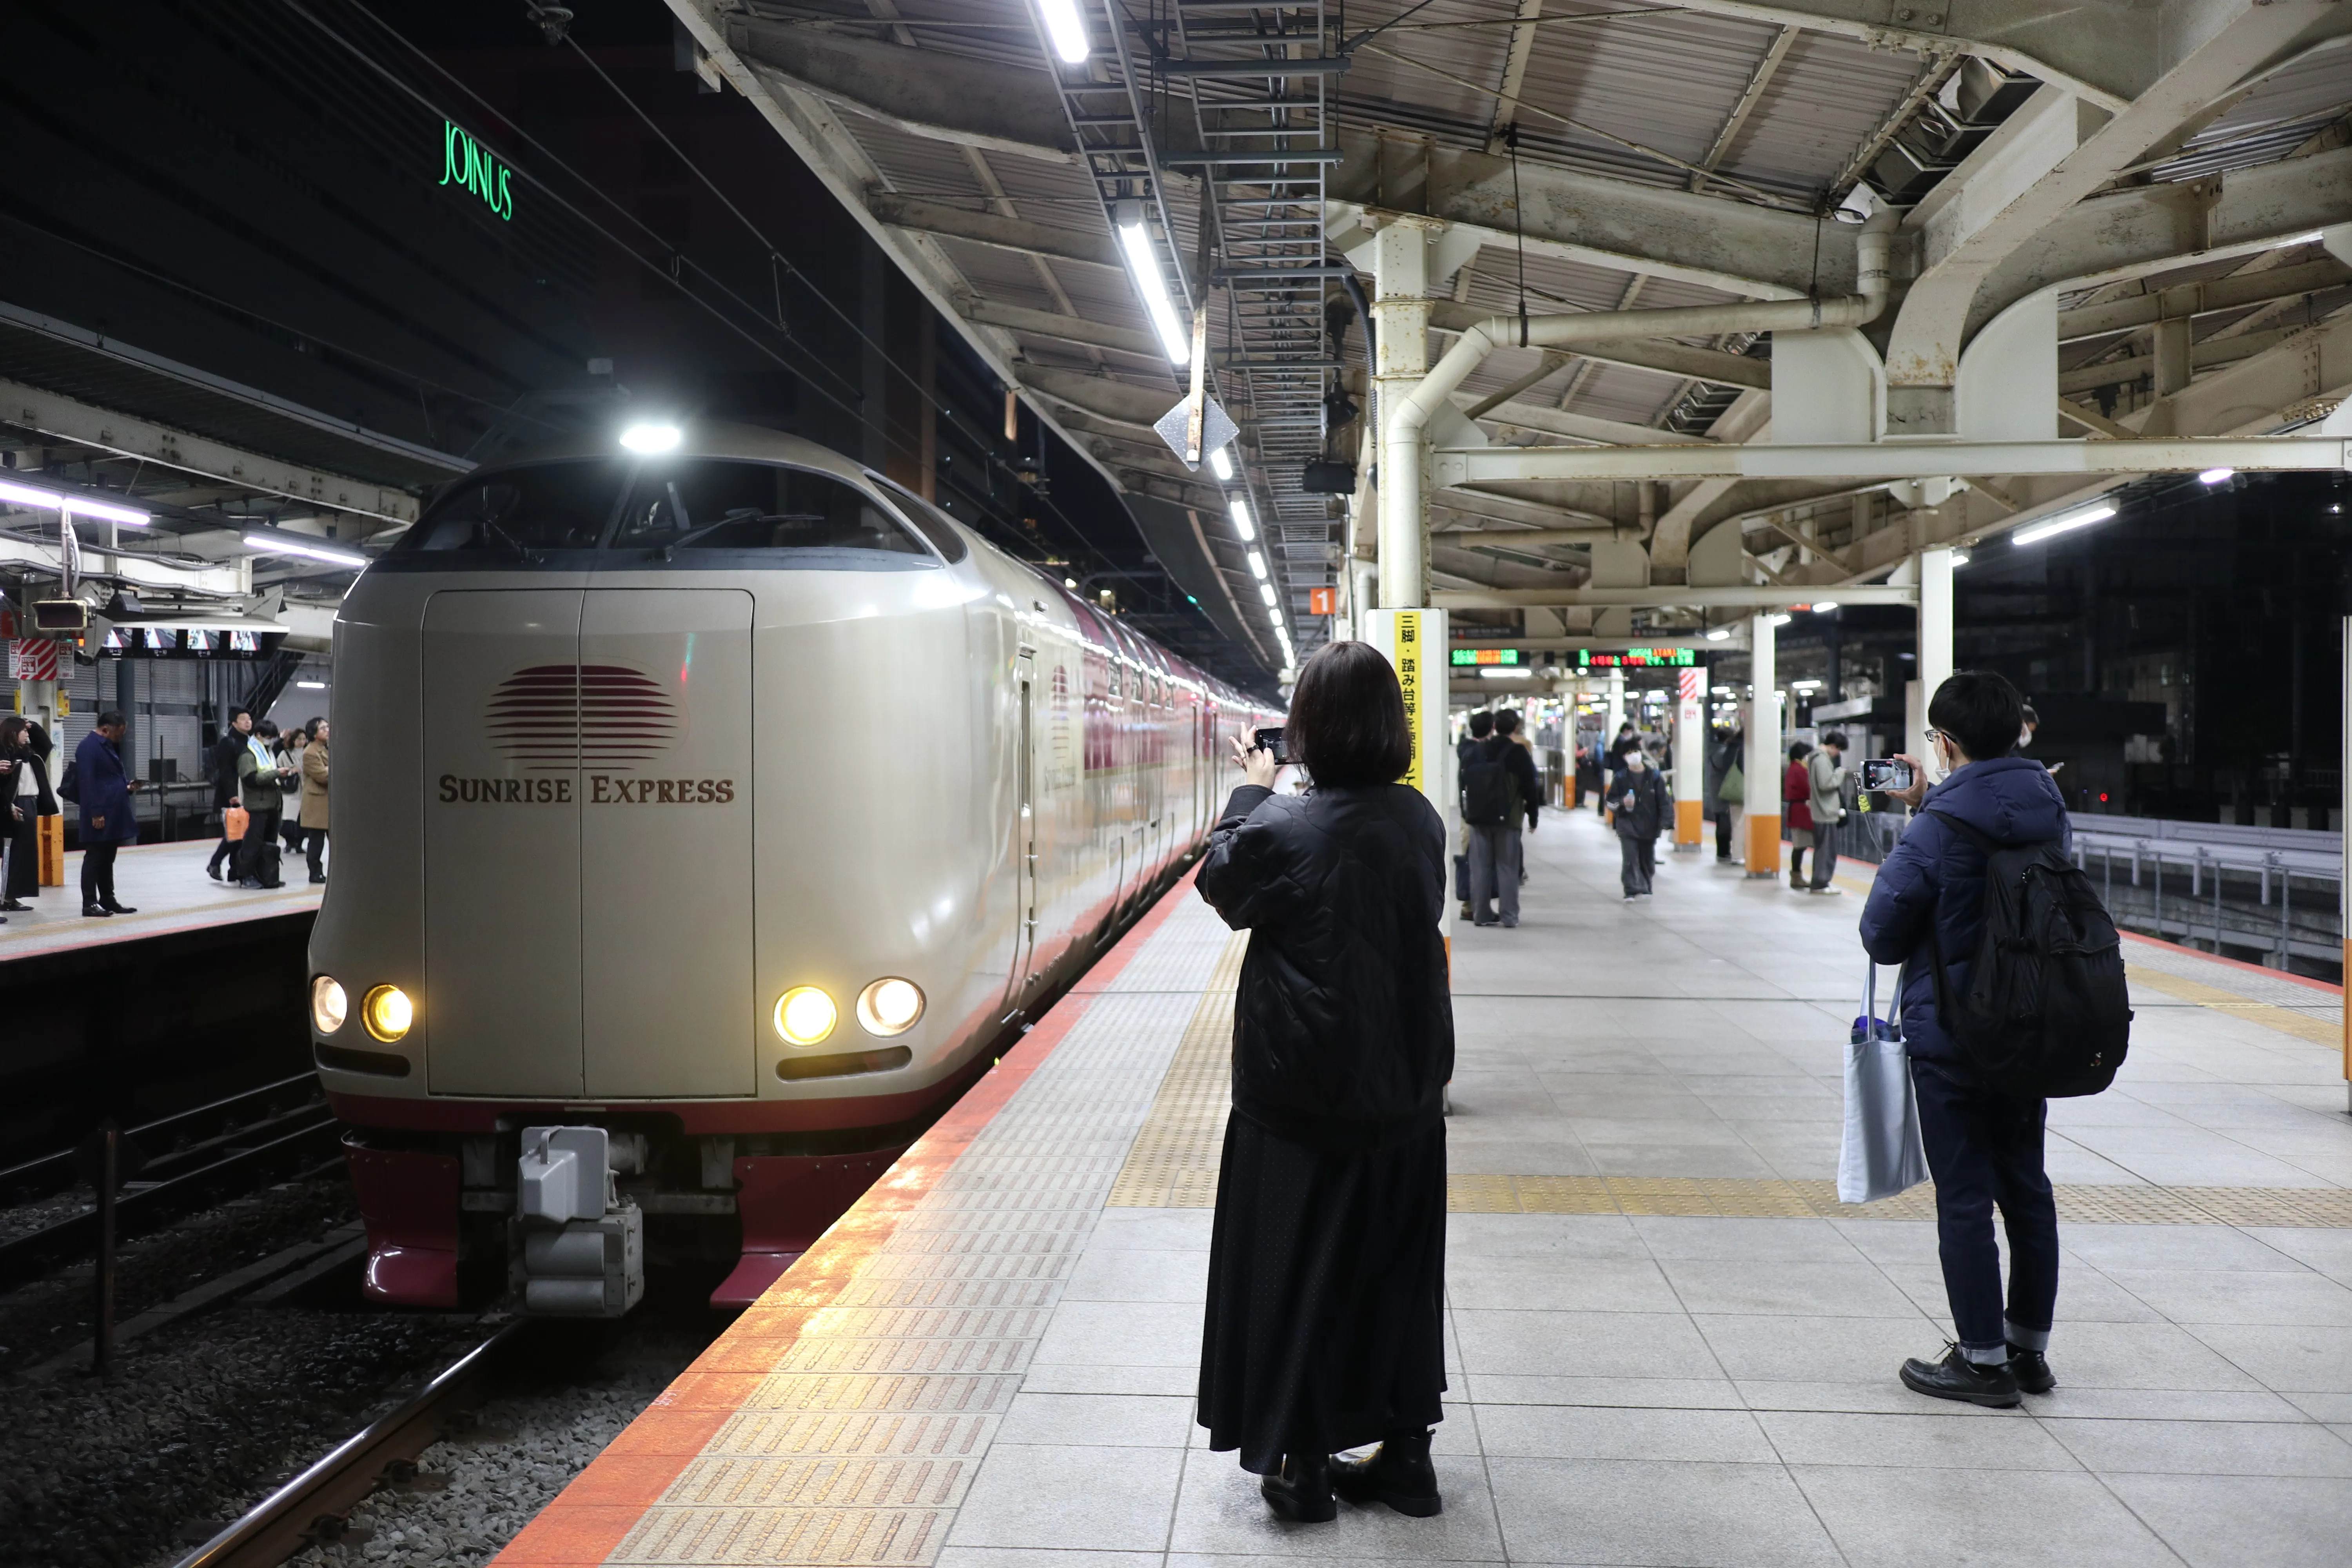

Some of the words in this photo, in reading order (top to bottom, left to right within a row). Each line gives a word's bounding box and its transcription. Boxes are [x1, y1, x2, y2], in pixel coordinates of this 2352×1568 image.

[438, 120, 512, 222] JOINUS
[1318, 591, 1329, 612] 1
[439, 774, 572, 803] SUNRISE
[591, 775, 734, 803] EXPRESS
